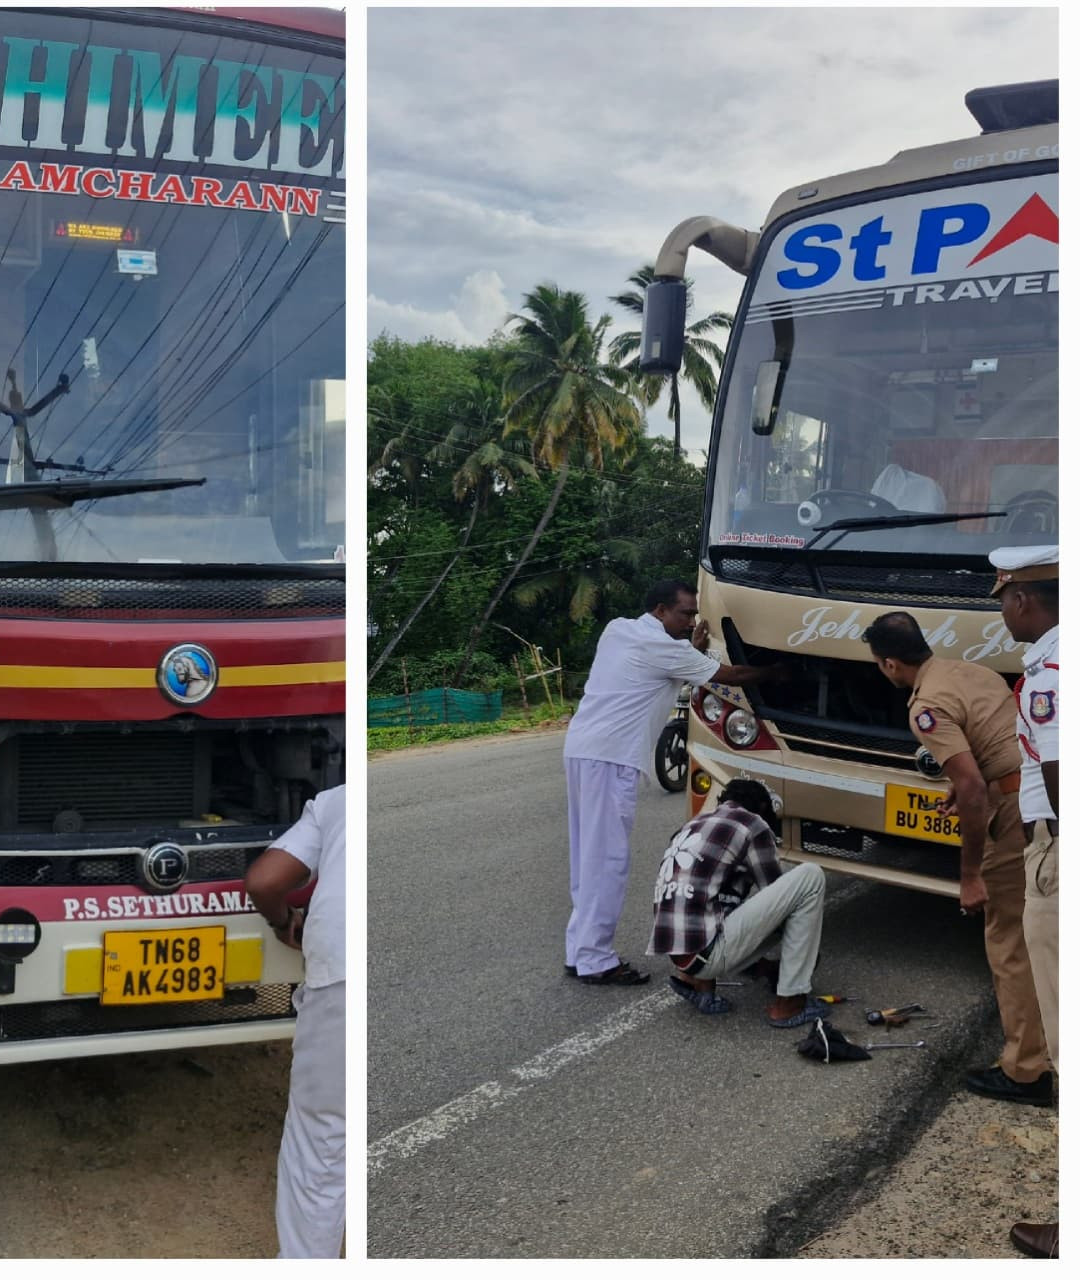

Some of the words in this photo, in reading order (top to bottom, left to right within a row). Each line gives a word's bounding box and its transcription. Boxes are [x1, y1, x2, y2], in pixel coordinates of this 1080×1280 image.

[953, 152, 997, 170] GIFT
[1004, 147, 1029, 161] OF
[777, 216, 892, 290] St
[767, 535, 805, 547] Booking
[896, 810, 918, 829] BU
[923, 815, 961, 837] 3884
[139, 937, 201, 965] TN68
[122, 966, 217, 996] AK4983
